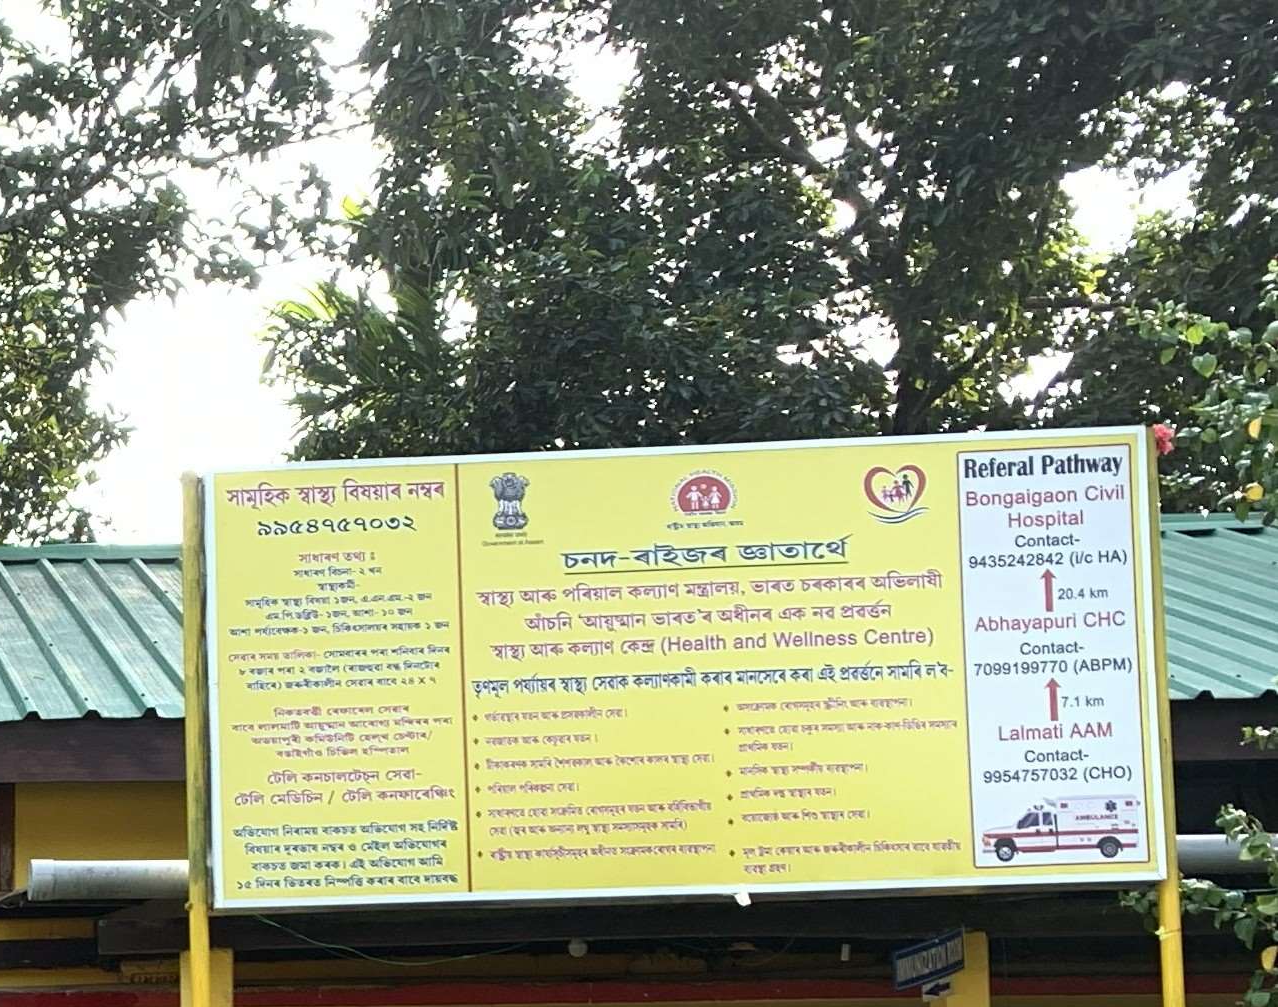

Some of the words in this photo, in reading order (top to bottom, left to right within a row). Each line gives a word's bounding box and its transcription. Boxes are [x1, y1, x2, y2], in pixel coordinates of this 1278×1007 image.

[964, 456, 1034, 478] Referal
[1043, 454, 1123, 476] Pathway
[227, 482, 290, 509] সামূহিক
[296, 484, 336, 507] স্বাস্থ্য
[343, 479, 401, 502] বিষয়াৰ
[408, 482, 444, 499] নম্বৰ
[966, 489, 1077, 509] Bongaigaon
[1085, 485, 1124, 501] Civil
[258, 515, 417, 535] ৯৯৫৪৭৫৭০৩২
[1008, 510, 1083, 529] Hospital
[1015, 534, 1080, 548] Contact-
[969, 553, 1063, 568] 9435242842
[1070, 551, 1093, 566] (i/c
[1098, 549, 1127, 565] HA)
[476, 590, 513, 608] স্বাস্থ্য
[520, 589, 557, 604] আৰু
[563, 583, 622, 602] পৰিয়াল
[627, 583, 679, 598] কল্যাণ
[751, 580, 794, 593] ভাৰত
[801, 577, 865, 591] চৰকাৰৰ
[1058, 588, 1084, 599] 20.4
[1090, 588, 1108, 598] km
[524, 612, 572, 631] আঁচনি
[717, 604, 772, 622] অধীনৰ
[779, 607, 807, 620] এক
[975, 614, 1076, 633] Abhayapuri
[1084, 611, 1125, 627] CHC
[491, 644, 525, 660] স্বাস্থ্য
[530, 643, 564, 656] আৰু
[568, 641, 614, 655] কল্যাণ
[660, 634, 726, 656] (Health
[733, 633, 766, 649] and
[773, 631, 857, 647] Wellness
[864, 628, 934, 646] Centre)
[1020, 642, 1085, 655] Contact-
[974, 661, 1068, 676] 7099199770
[1074, 658, 1132, 675] (ABPM)
[559, 677, 586, 695] স্বাস্থ্য
[790, 667, 813, 682] কৰা
[819, 665, 837, 683] এই
[1062, 697, 1080, 707] 7.1
[1086, 696, 1104, 706] km
[999, 724, 1062, 741] Lalmati
[1071, 722, 1112, 737] AAM
[1025, 749, 1089, 763] Contact-
[268, 770, 297, 785] টেলি
[984, 768, 1077, 783] 9954757032
[1083, 766, 1132, 783] (CHO)
[235, 792, 264, 806] টেলি
[343, 789, 371, 803] টেলি
